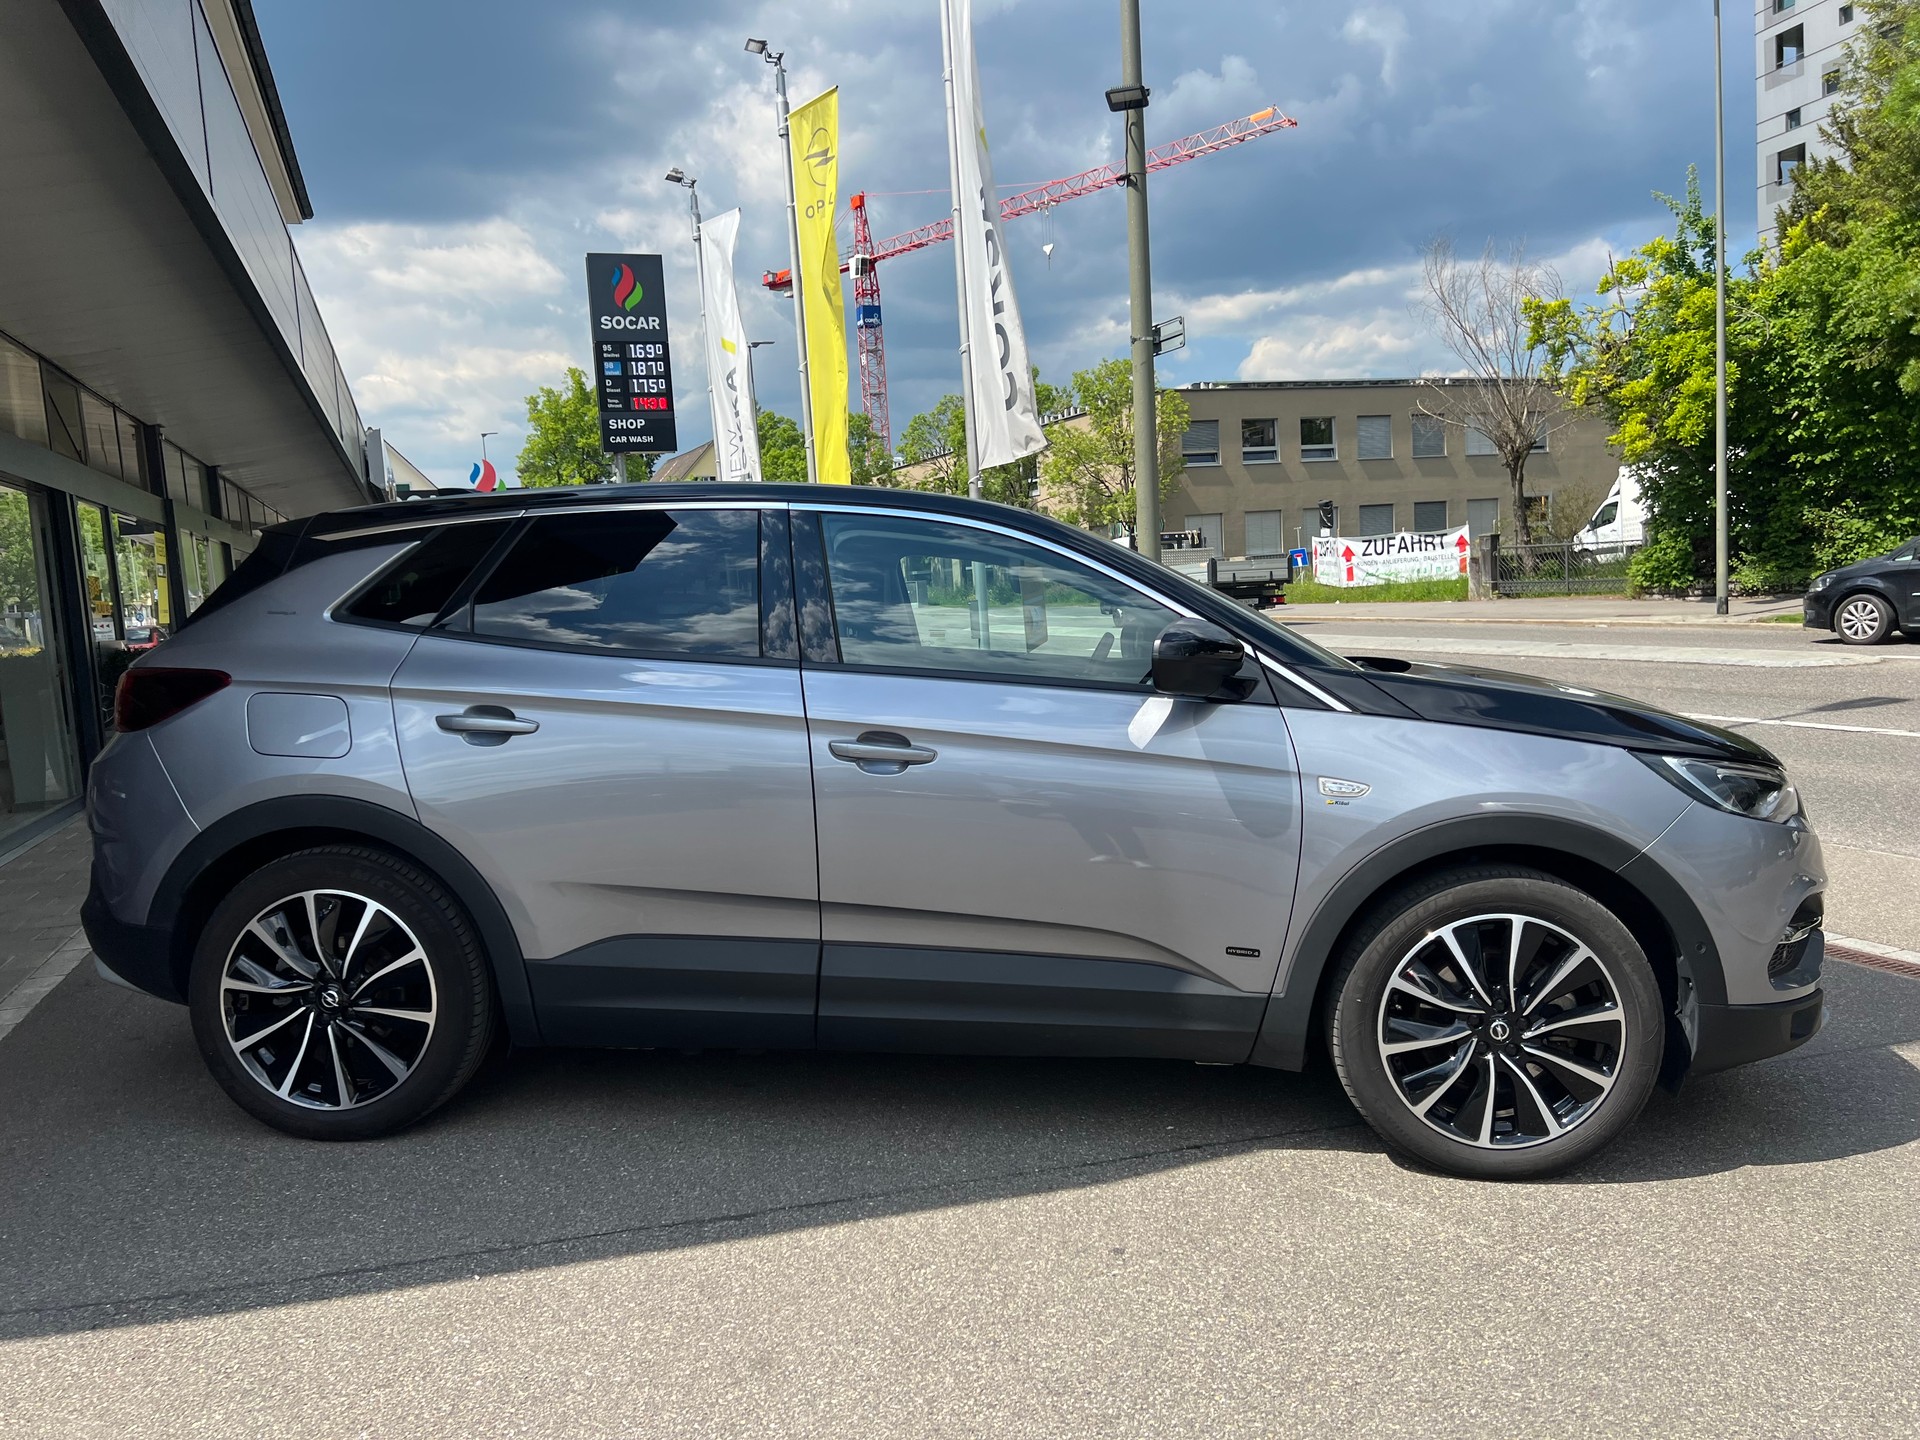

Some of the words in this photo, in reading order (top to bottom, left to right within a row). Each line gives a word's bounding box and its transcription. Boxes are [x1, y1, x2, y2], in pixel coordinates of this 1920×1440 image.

[600, 315, 660, 330] SOCAR
[604, 361, 614, 369] 98
[608, 418, 646, 429] SHOP
[628, 435, 654, 443] WASH
[1362, 532, 1448, 557] ZUFAHRT
[1382, 556, 1419, 566] ANLIEFERUNG
